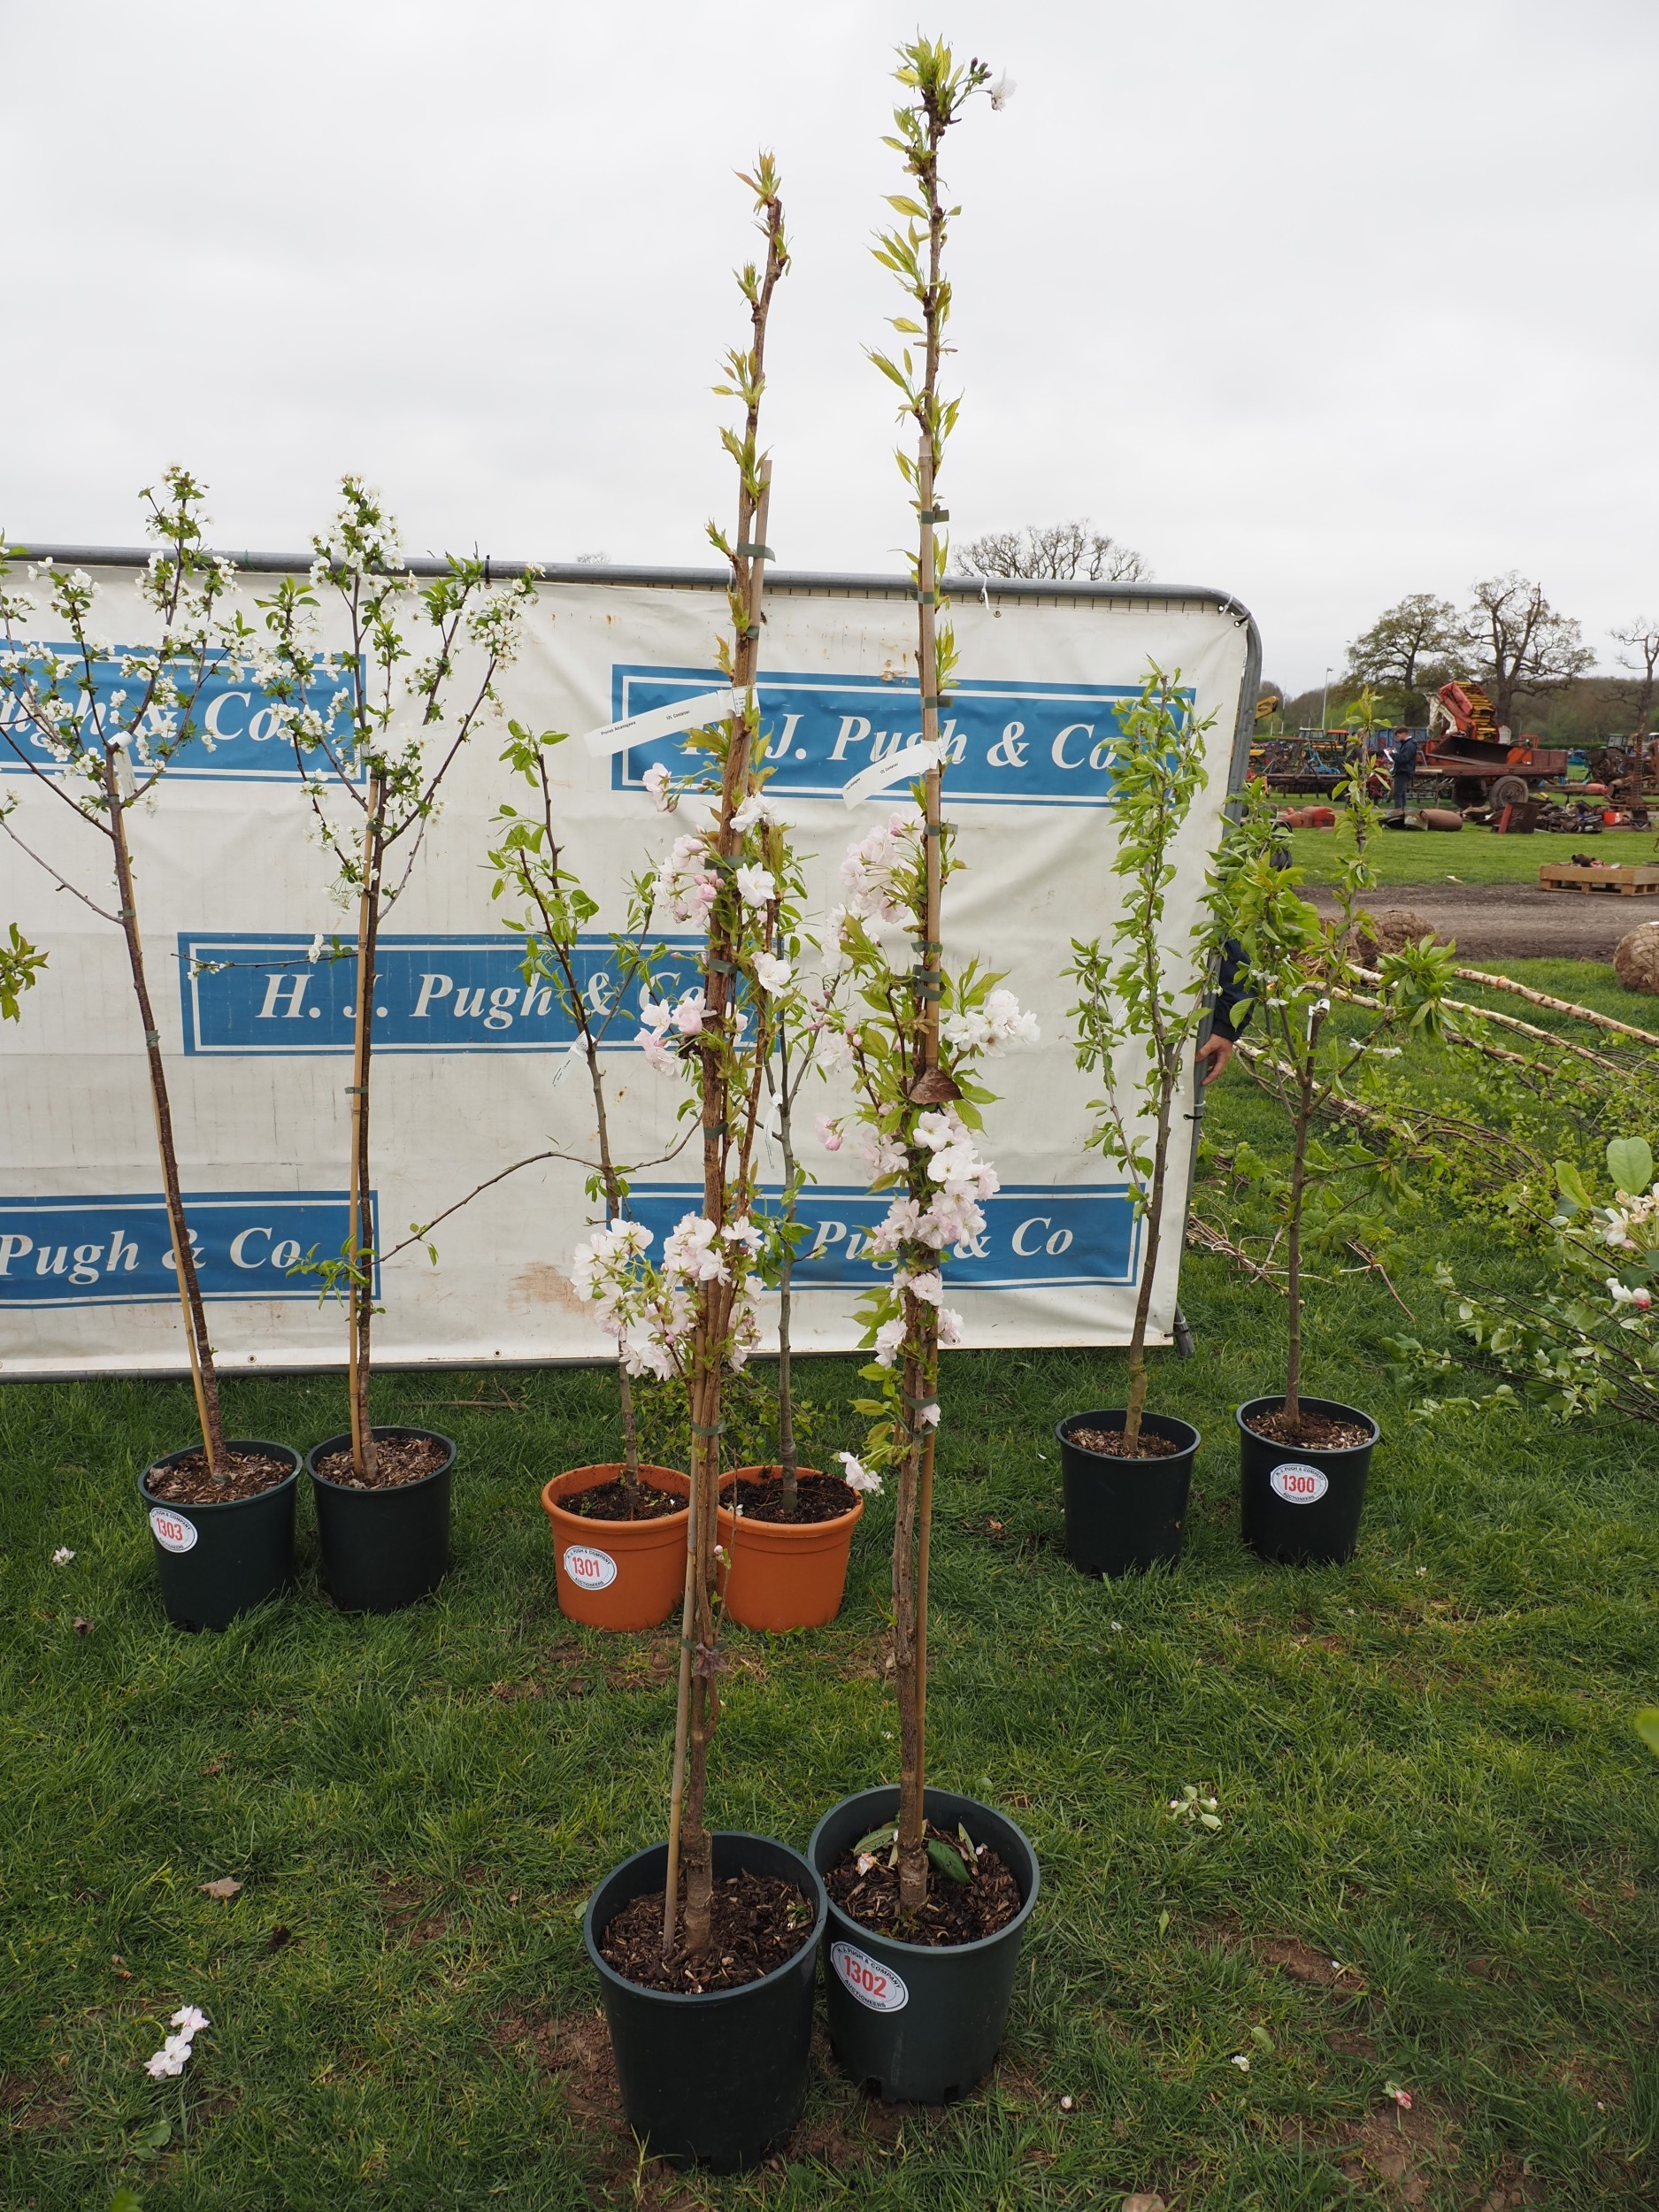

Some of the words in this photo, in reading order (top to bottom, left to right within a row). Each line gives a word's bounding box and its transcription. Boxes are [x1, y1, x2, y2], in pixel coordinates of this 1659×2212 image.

[204, 691, 281, 741] Co
[764, 713, 807, 759] J.
[826, 715, 967, 765] Puh
[987, 721, 1030, 768] &
[1051, 723, 1118, 770] Co
[255, 974, 321, 1018] H.
[409, 972, 553, 1030] Pugh
[580, 972, 617, 1016] &
[1011, 1217, 1073, 1256] Co
[0, 1230, 140, 1285] Pugh
[230, 1226, 301, 1269] Co
[1282, 1474, 1315, 1494] 1300
[1303, 1468, 1324, 1481] COMPANY
[156, 1517, 183, 1540] 1303
[572, 1556, 600, 1578] 1301
[844, 1955, 887, 1999] 1302
[871, 1962, 902, 1989] COMPANY
[844, 1979, 887, 2008] AUCTIONEERS
